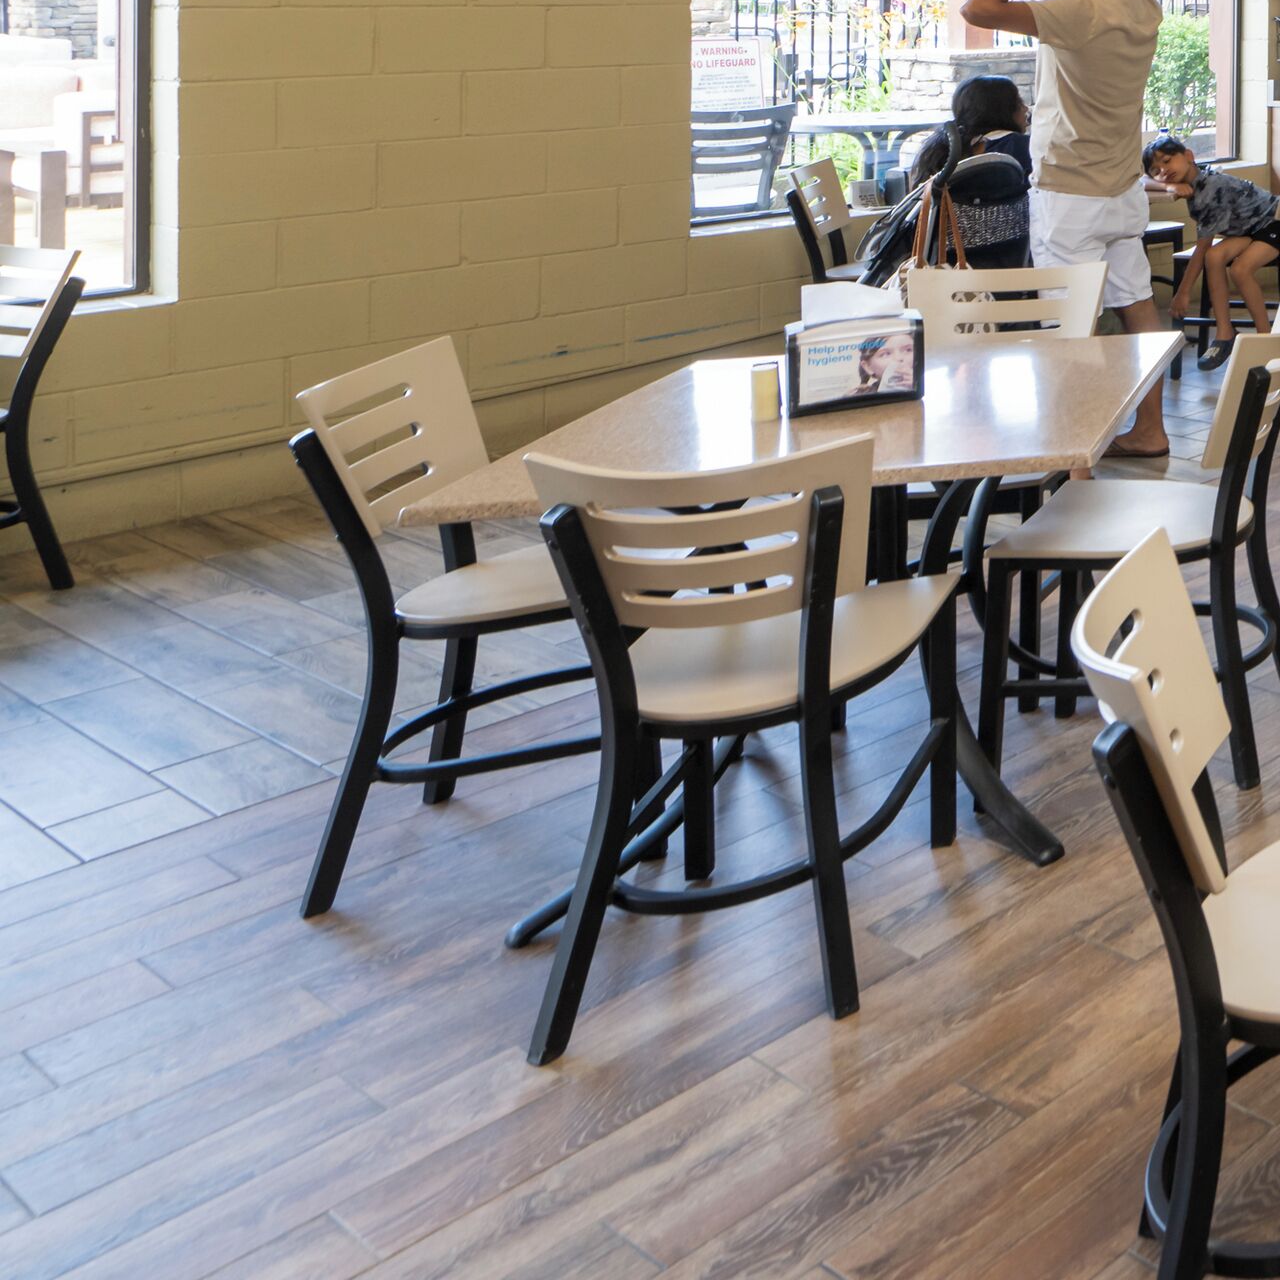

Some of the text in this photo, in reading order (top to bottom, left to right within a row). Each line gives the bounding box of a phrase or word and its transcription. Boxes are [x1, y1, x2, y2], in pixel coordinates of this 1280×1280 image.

[700, 47, 744, 56] WARNING
[706, 58, 756, 68] LIFEGUARD
[808, 337, 887, 355] Help promote
[808, 354, 853, 366] hygiene
